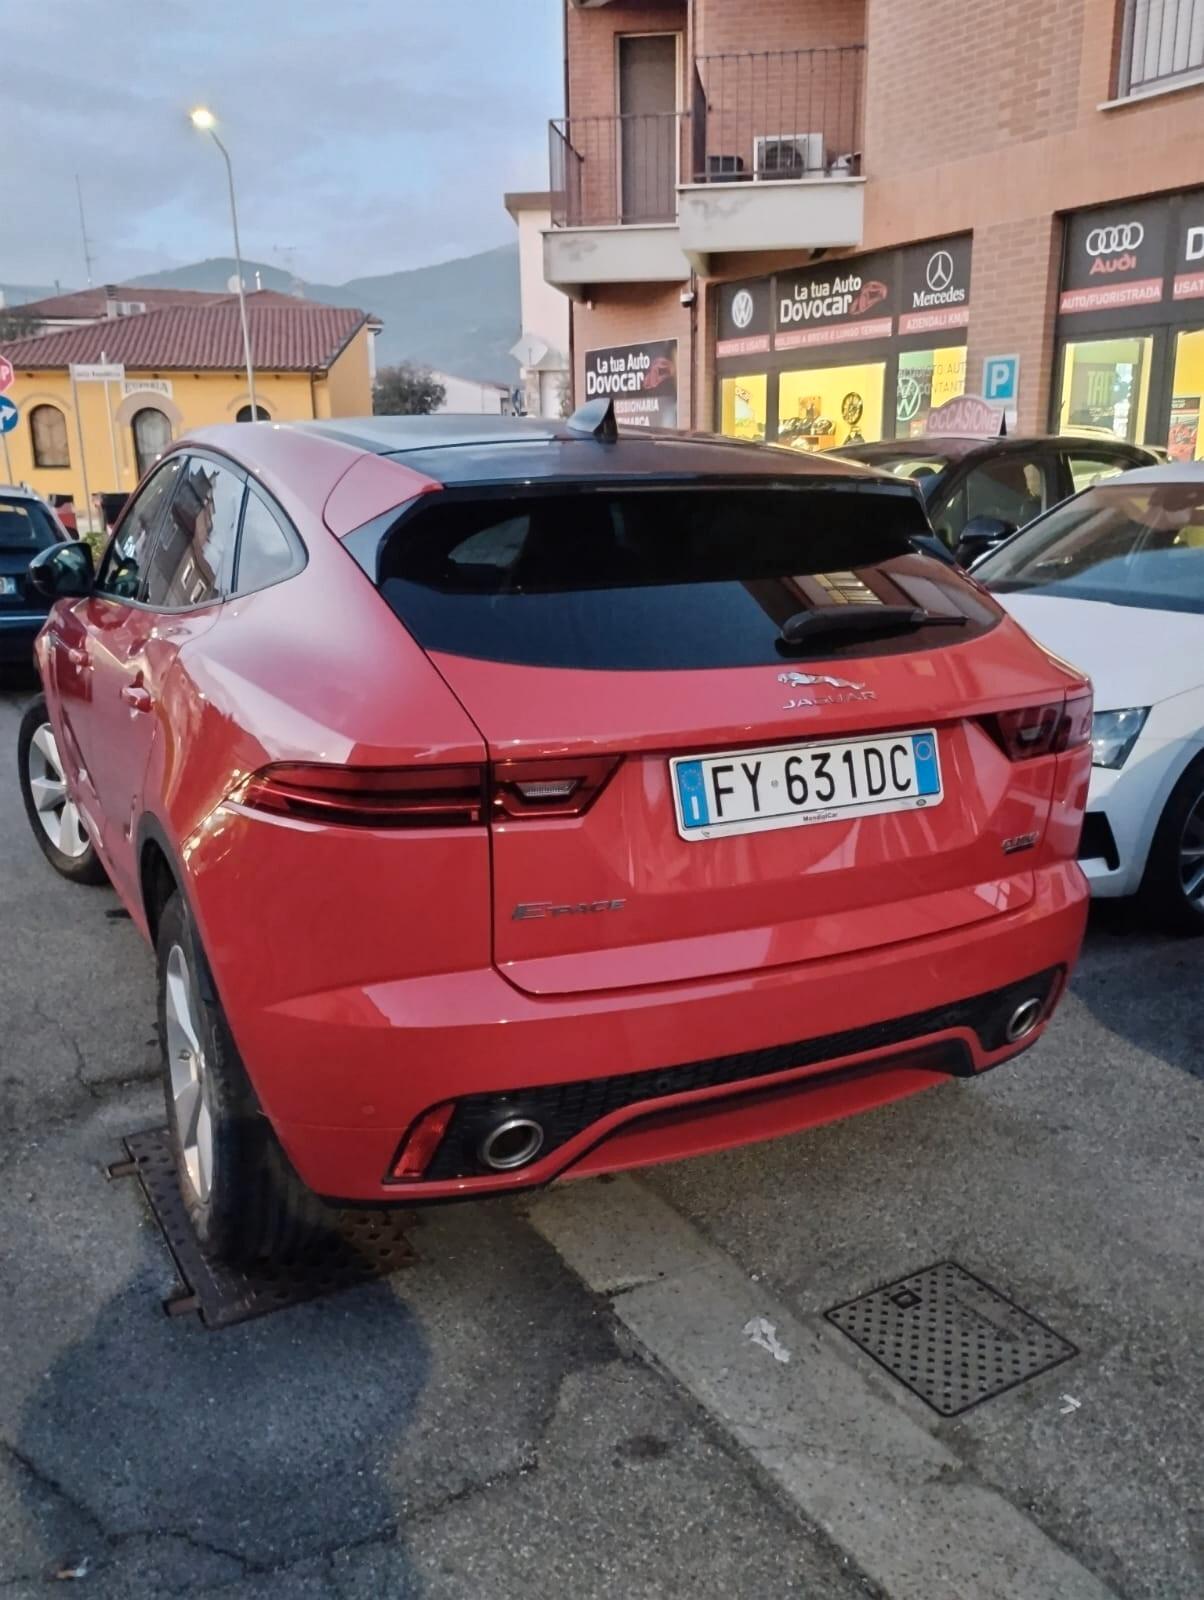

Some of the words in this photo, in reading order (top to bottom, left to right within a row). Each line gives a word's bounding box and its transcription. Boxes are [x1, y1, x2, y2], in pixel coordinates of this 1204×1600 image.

[1089, 254, 1137, 275] Audi
[795, 285, 808, 300] La
[811, 281, 830, 297] tua
[833, 274, 862, 294] Auto
[913, 286, 965, 308] Mercedes
[780, 294, 853, 323] Dovocar
[597, 357, 608, 373] La
[610, 356, 625, 372] tua
[627, 352, 650, 370] Auto
[586, 370, 645, 395] Dovocar
[991, 364, 1010, 396] P
[929, 400, 1000, 431] OCCASIONE
[782, 690, 876, 709] JAGUAR
[711, 761, 762, 818] FY
[784, 744, 912, 806] 631DC
